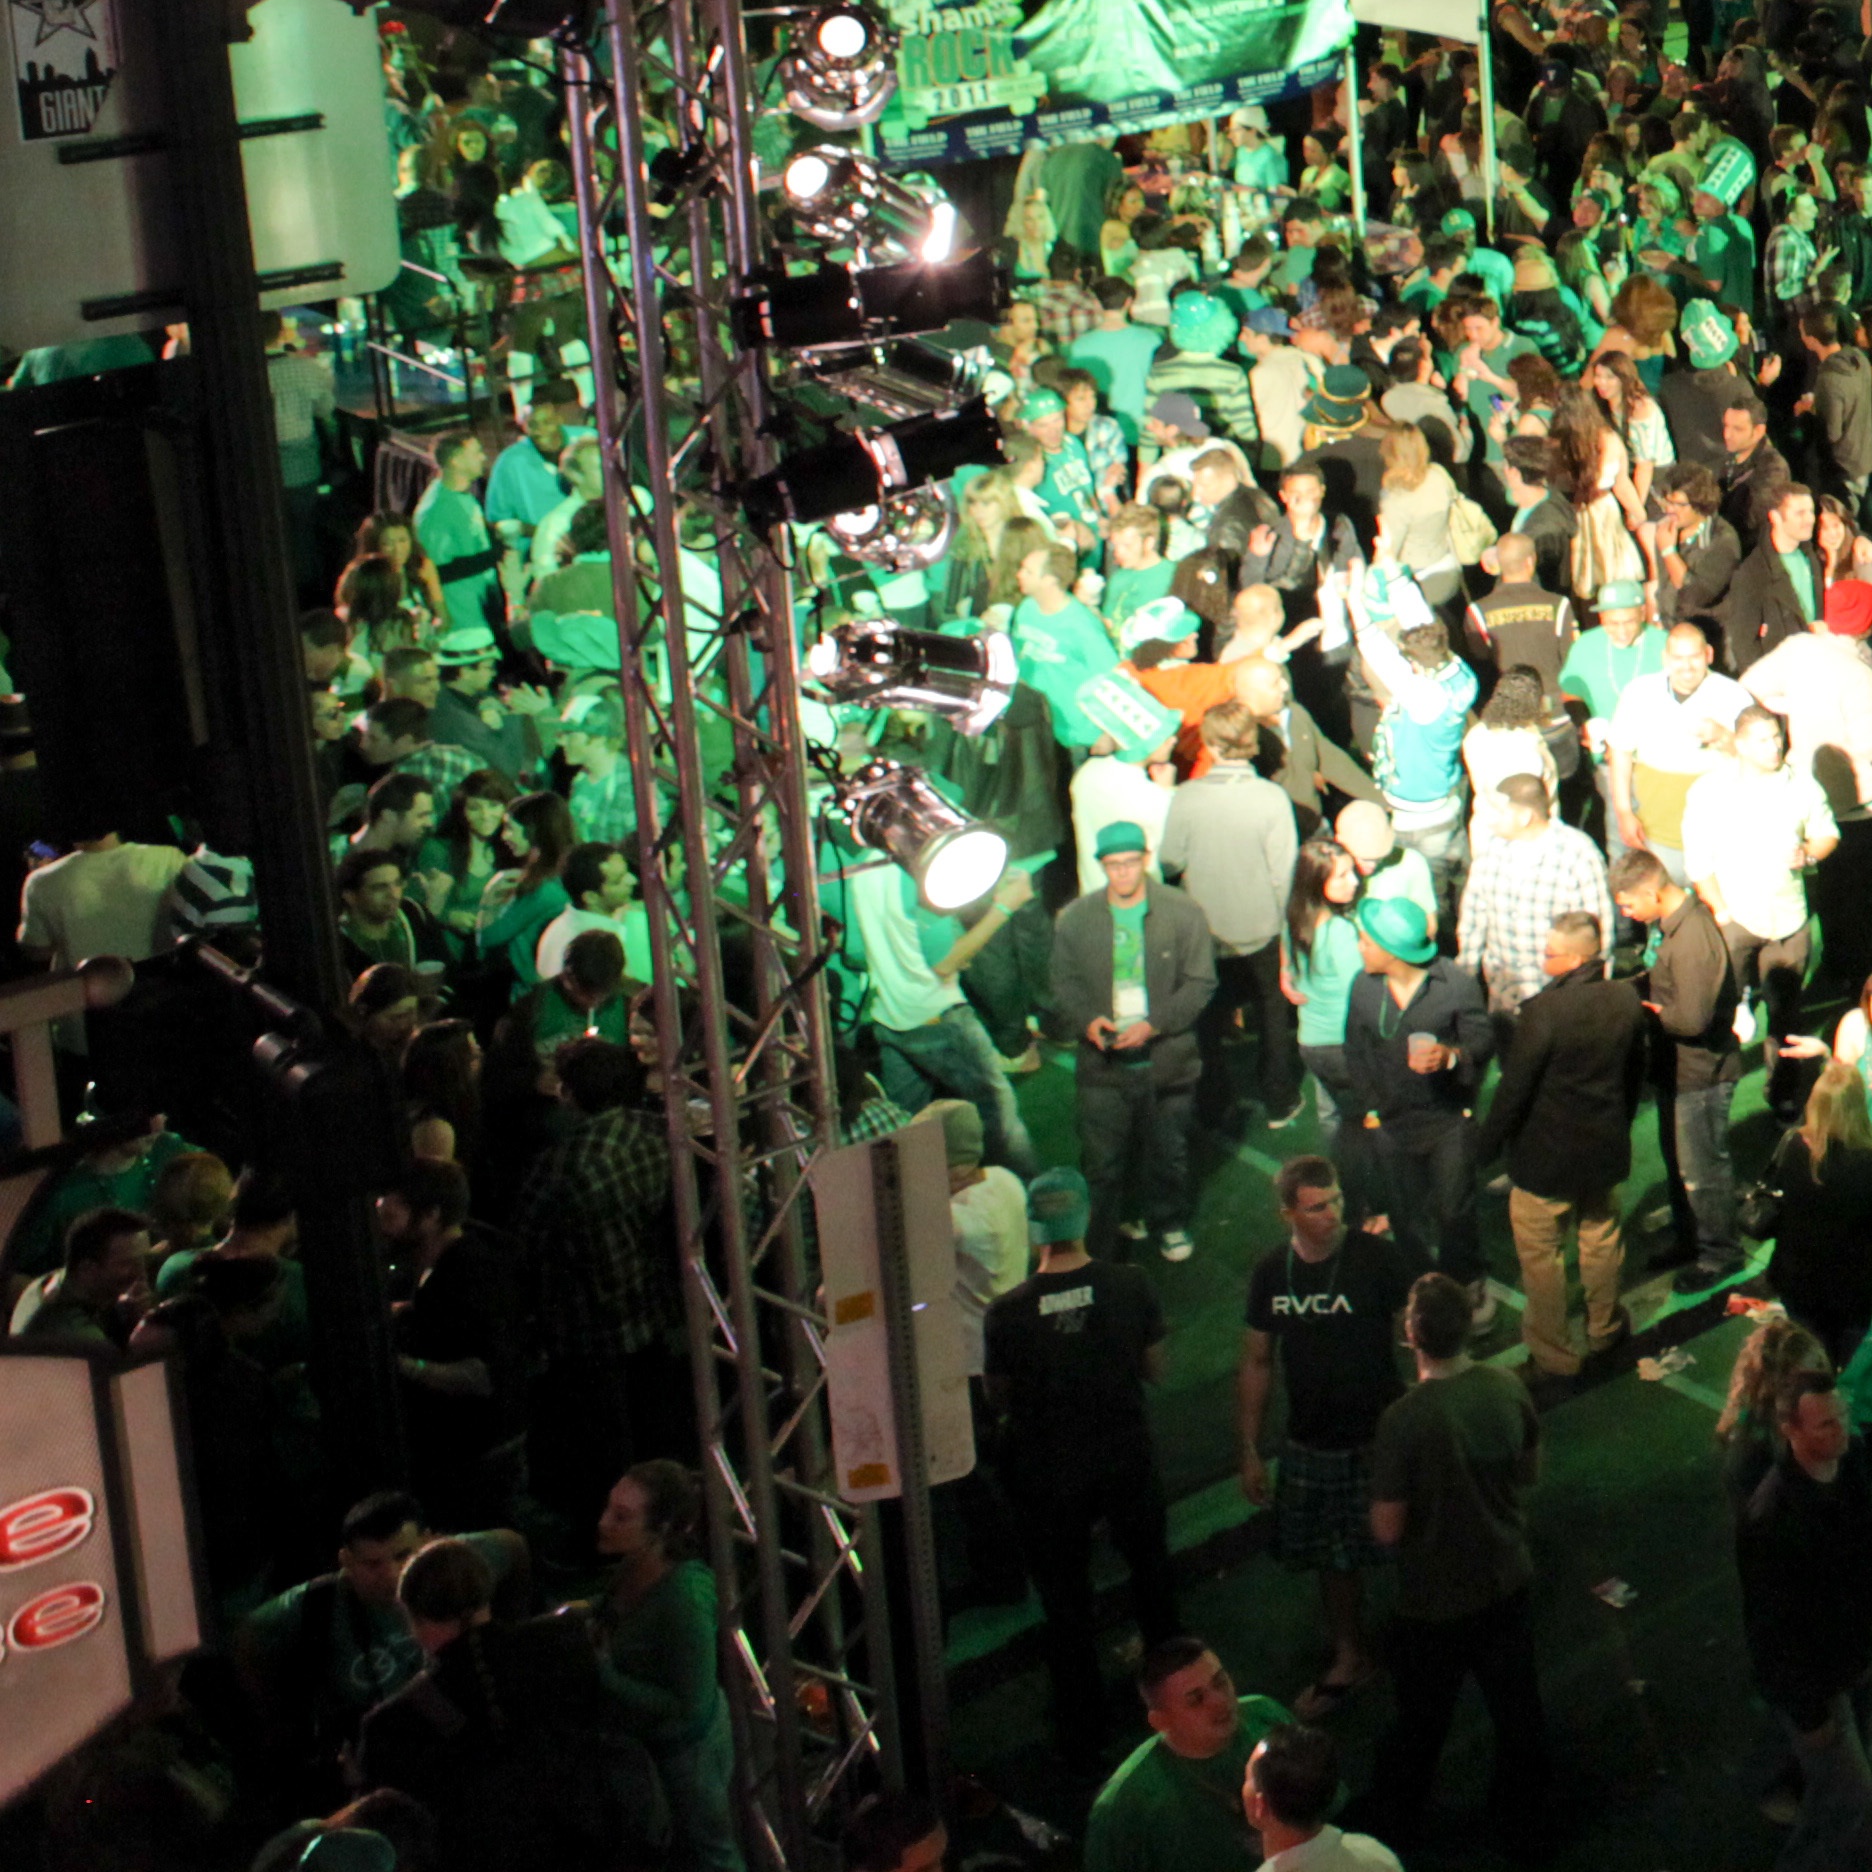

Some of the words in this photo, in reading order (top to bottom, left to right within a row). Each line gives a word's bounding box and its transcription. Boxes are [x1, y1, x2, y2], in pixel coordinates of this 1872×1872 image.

[900, 24, 1016, 92] ROCK
[933, 83, 990, 112] 2011
[1270, 1293, 1354, 1316] RVCA
